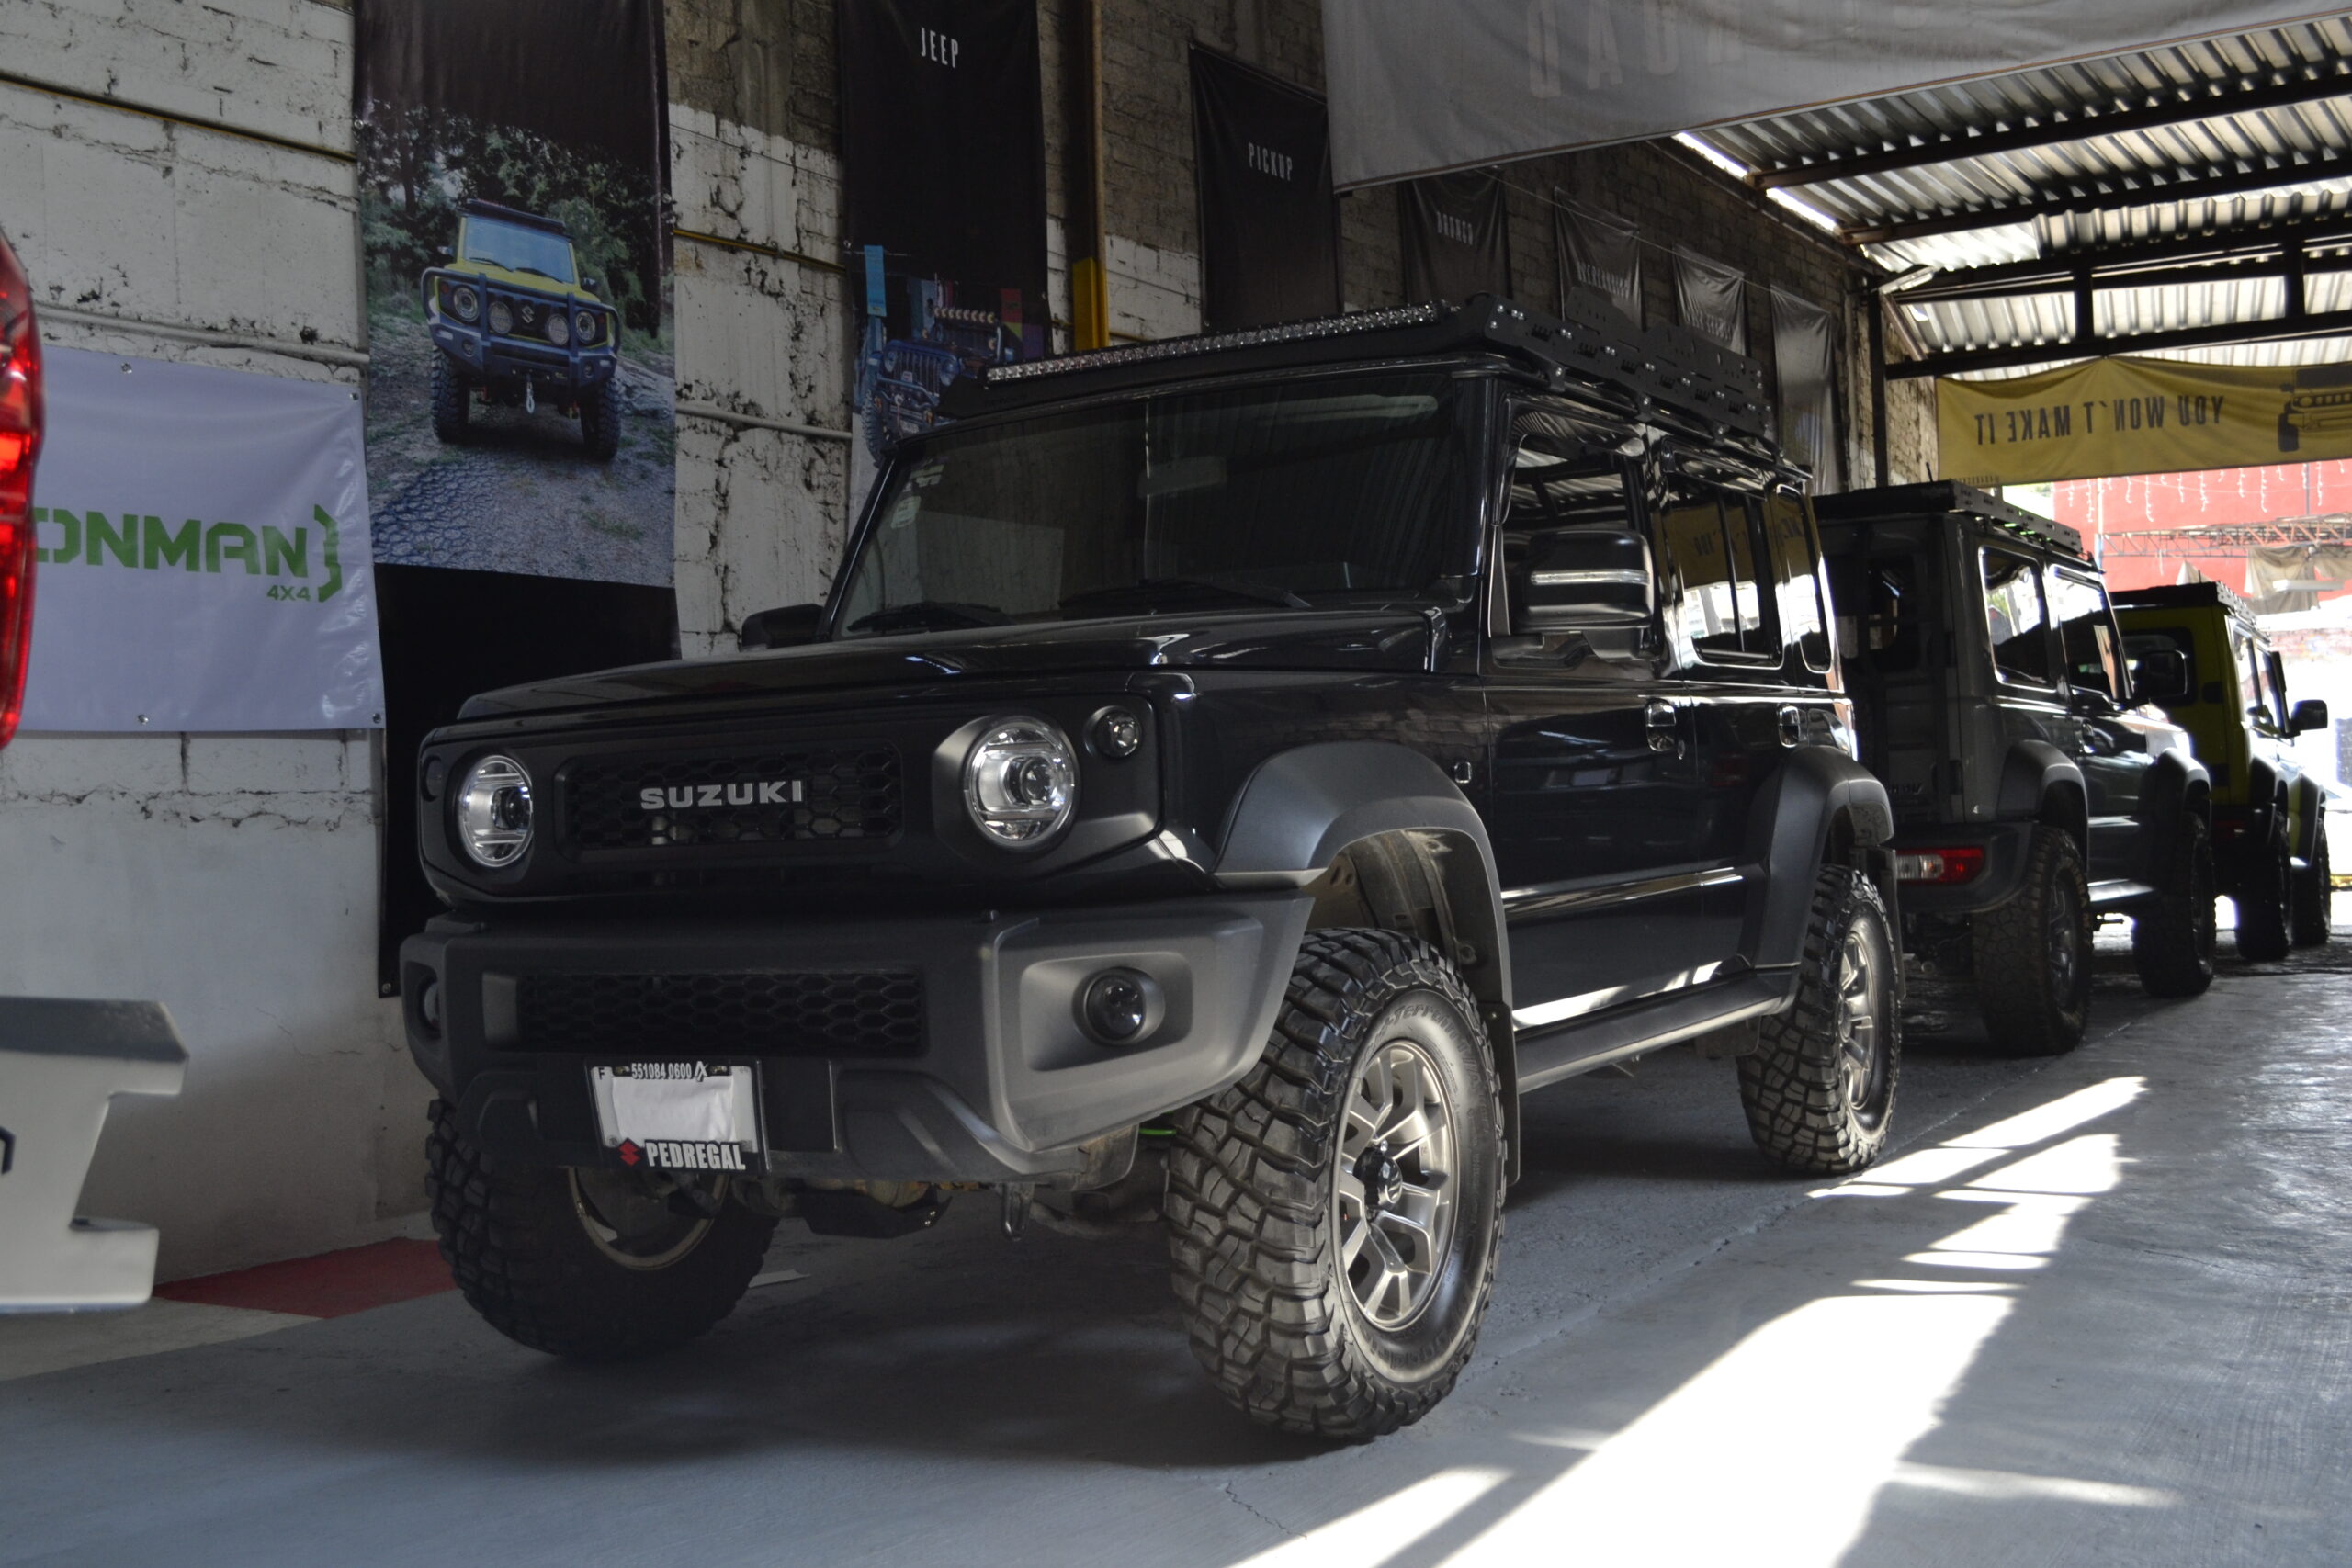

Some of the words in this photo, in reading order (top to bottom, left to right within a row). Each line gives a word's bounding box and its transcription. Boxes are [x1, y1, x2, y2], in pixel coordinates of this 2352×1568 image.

[921, 26, 959, 69] JEEP
[1248, 141, 1294, 182] PICKUP
[640, 780, 803, 810] SUZUKI
[645, 1141, 746, 1171] PEDREGAL
